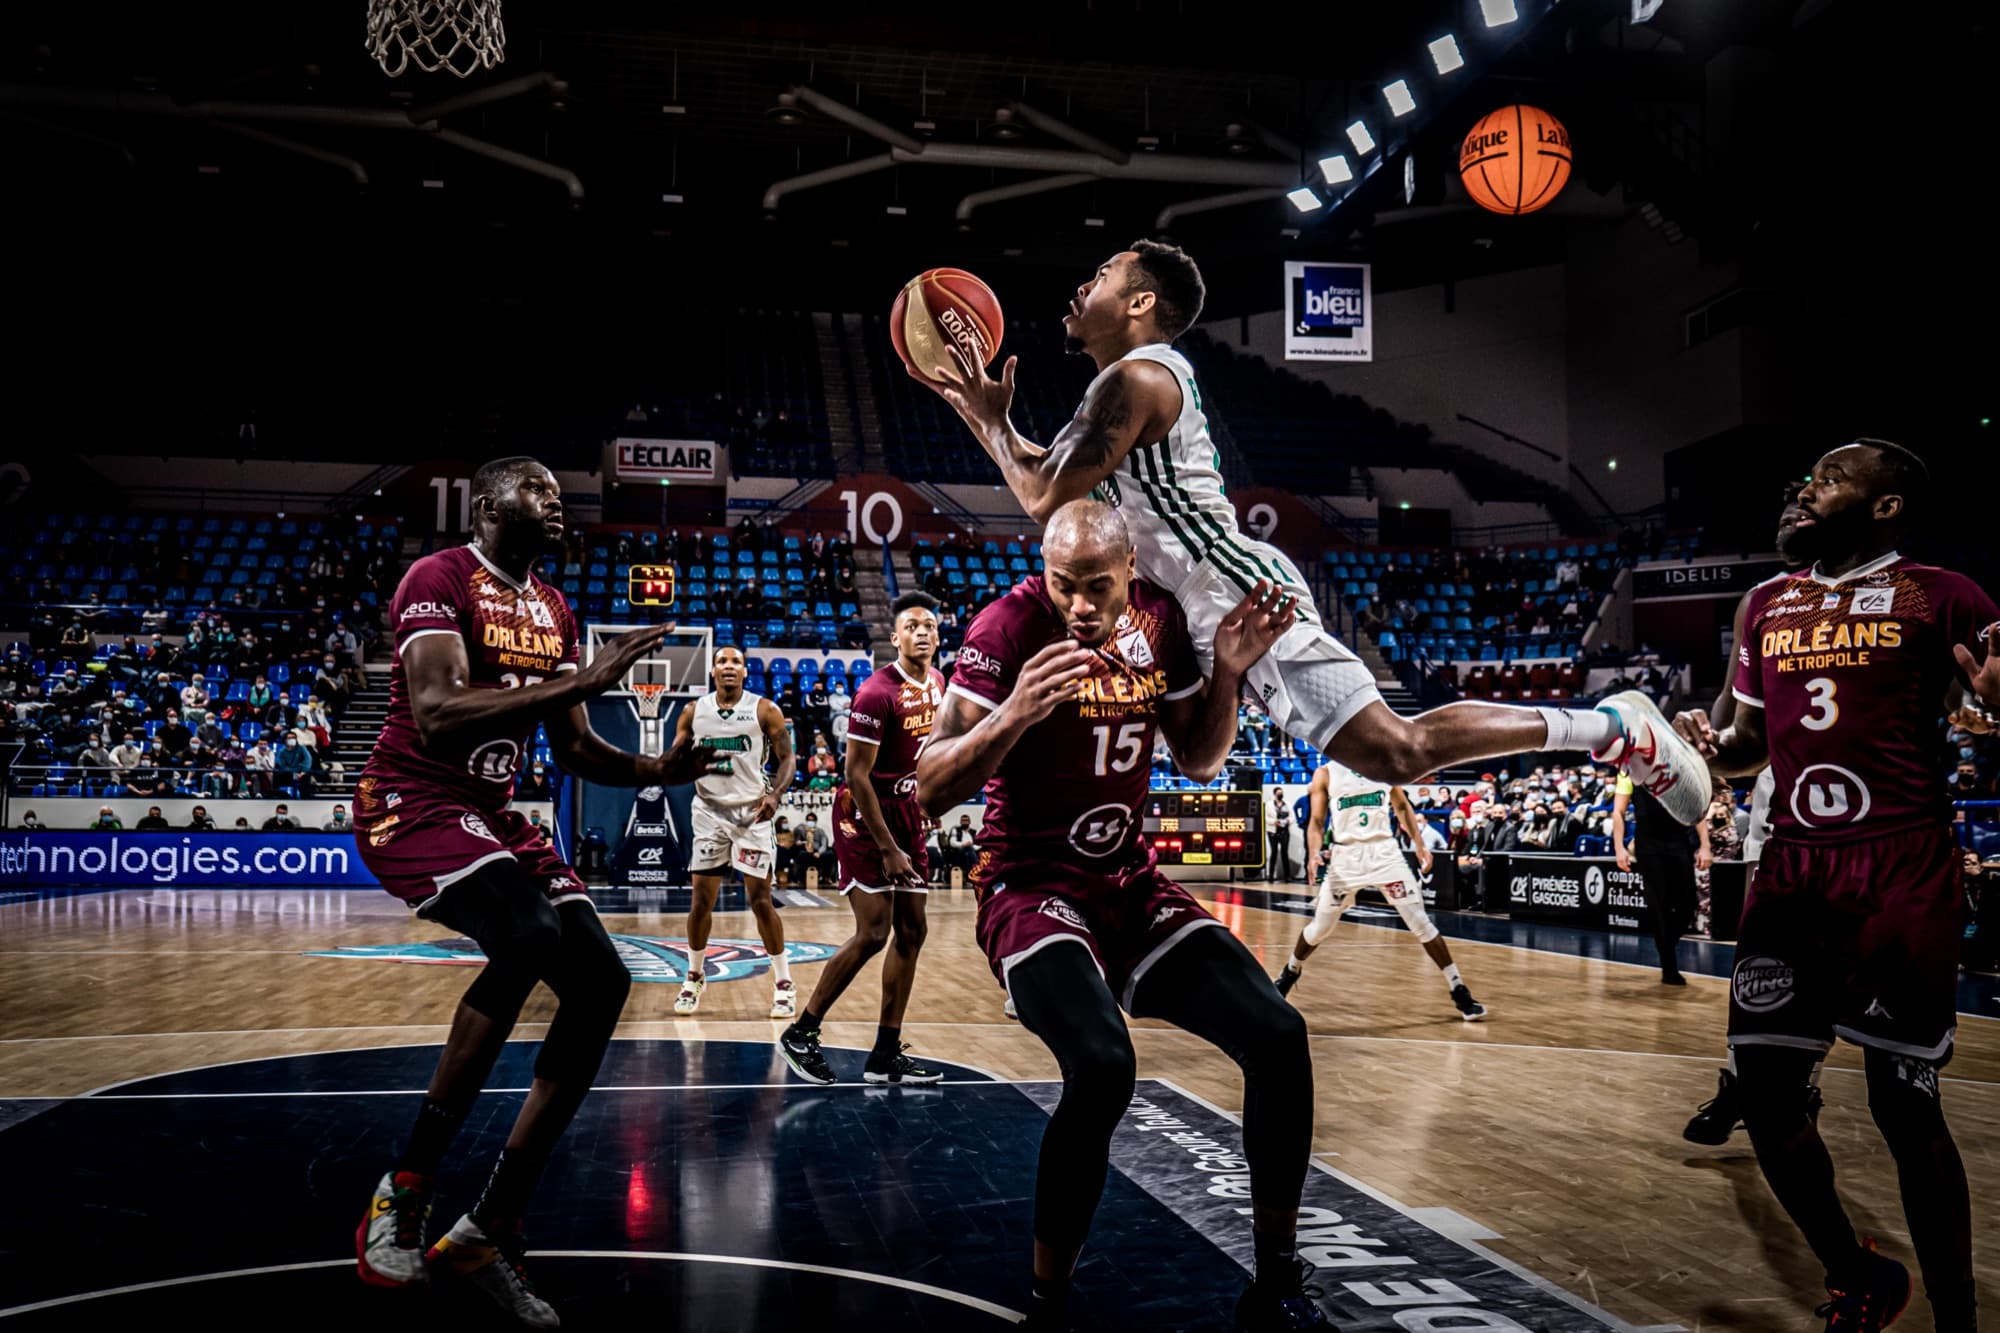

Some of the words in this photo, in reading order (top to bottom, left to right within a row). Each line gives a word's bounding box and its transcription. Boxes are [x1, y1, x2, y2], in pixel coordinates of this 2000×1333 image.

[1306, 289, 1361, 316] bleu
[840, 490, 904, 545] 10
[1664, 566, 1733, 584] IDELIS
[483, 623, 564, 659] ORLÉANS
[1761, 620, 1903, 658] ORLÉANS
[498, 651, 553, 672] MÉTROPOLE
[1777, 650, 1871, 673] MÉTROPOLE
[1800, 676, 1841, 732] 3
[1092, 721, 1147, 777] 15
[1359, 812, 1369, 828] 3
[0, 836, 349, 882] technologies.com
[1532, 876, 1580, 894] PYRÉNÉES
[1532, 891, 1581, 908] GASCOGNE
[1737, 976, 1794, 1001] KING
